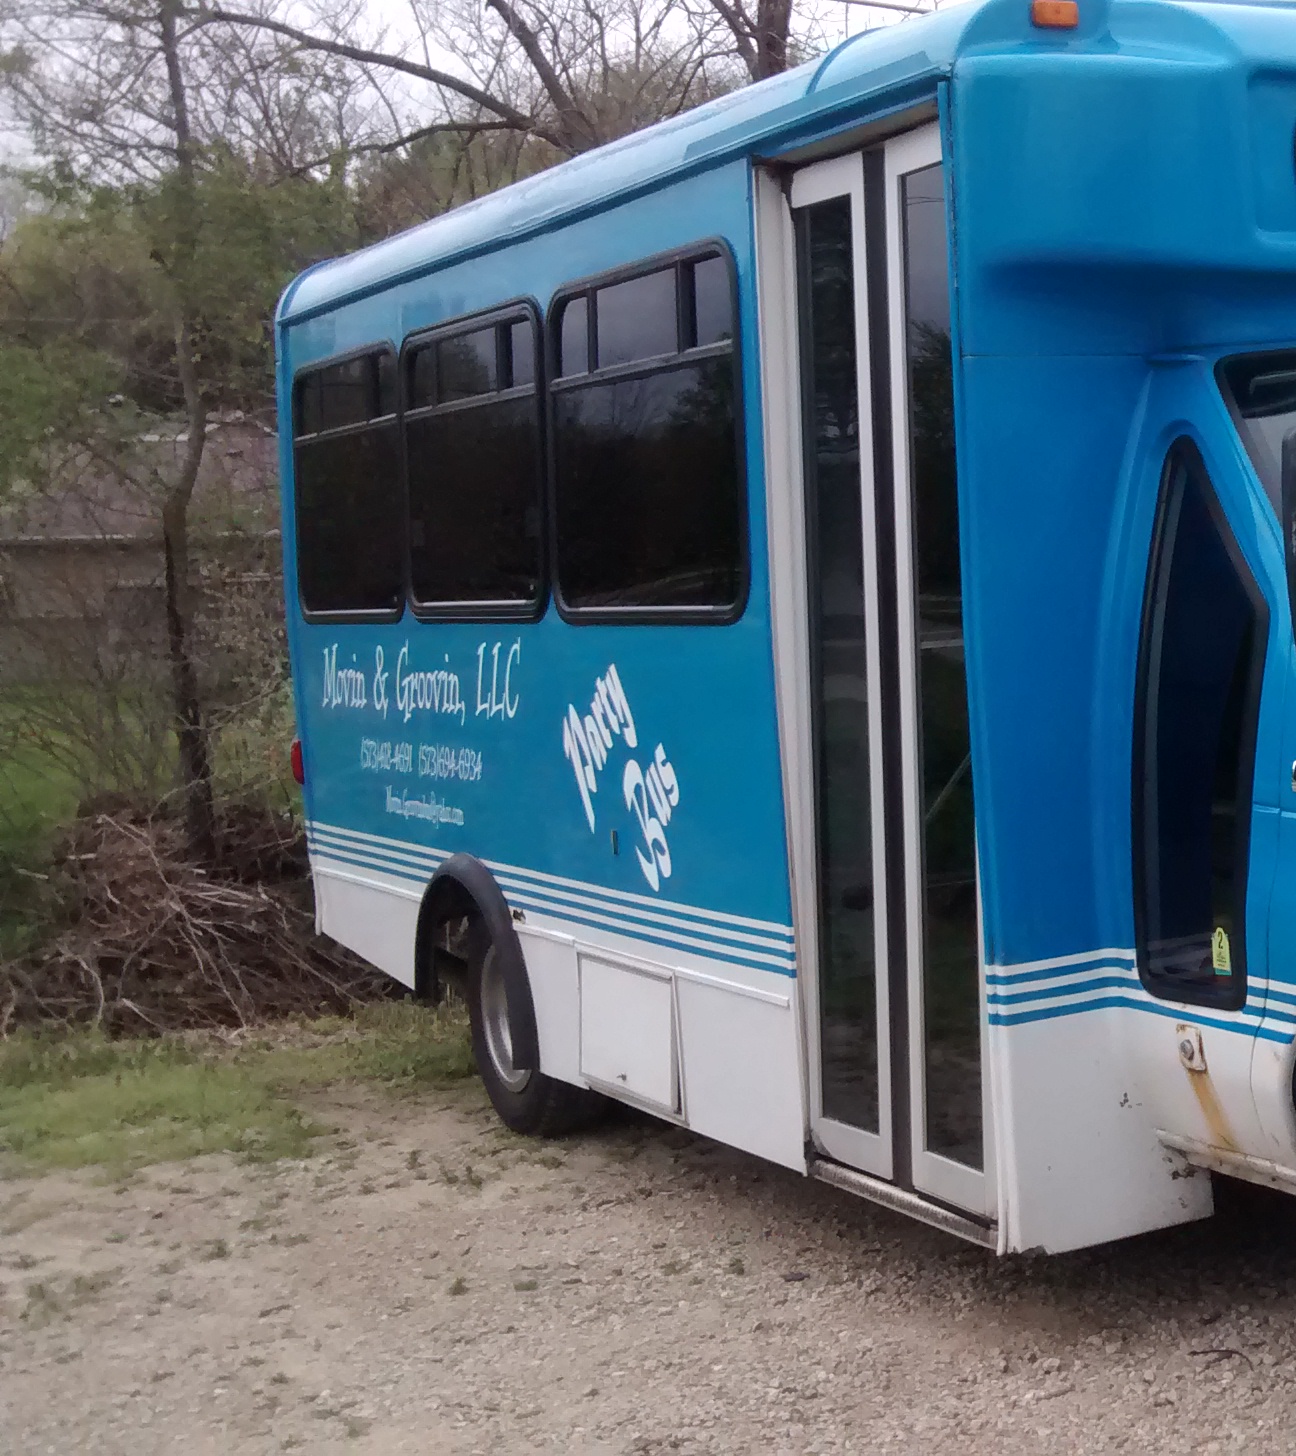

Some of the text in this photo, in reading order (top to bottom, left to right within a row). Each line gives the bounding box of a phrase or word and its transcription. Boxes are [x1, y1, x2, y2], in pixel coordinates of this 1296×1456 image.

[322, 637, 521, 724] Movin & Groovin, LLC
[563, 663, 680, 892] Party Bus
